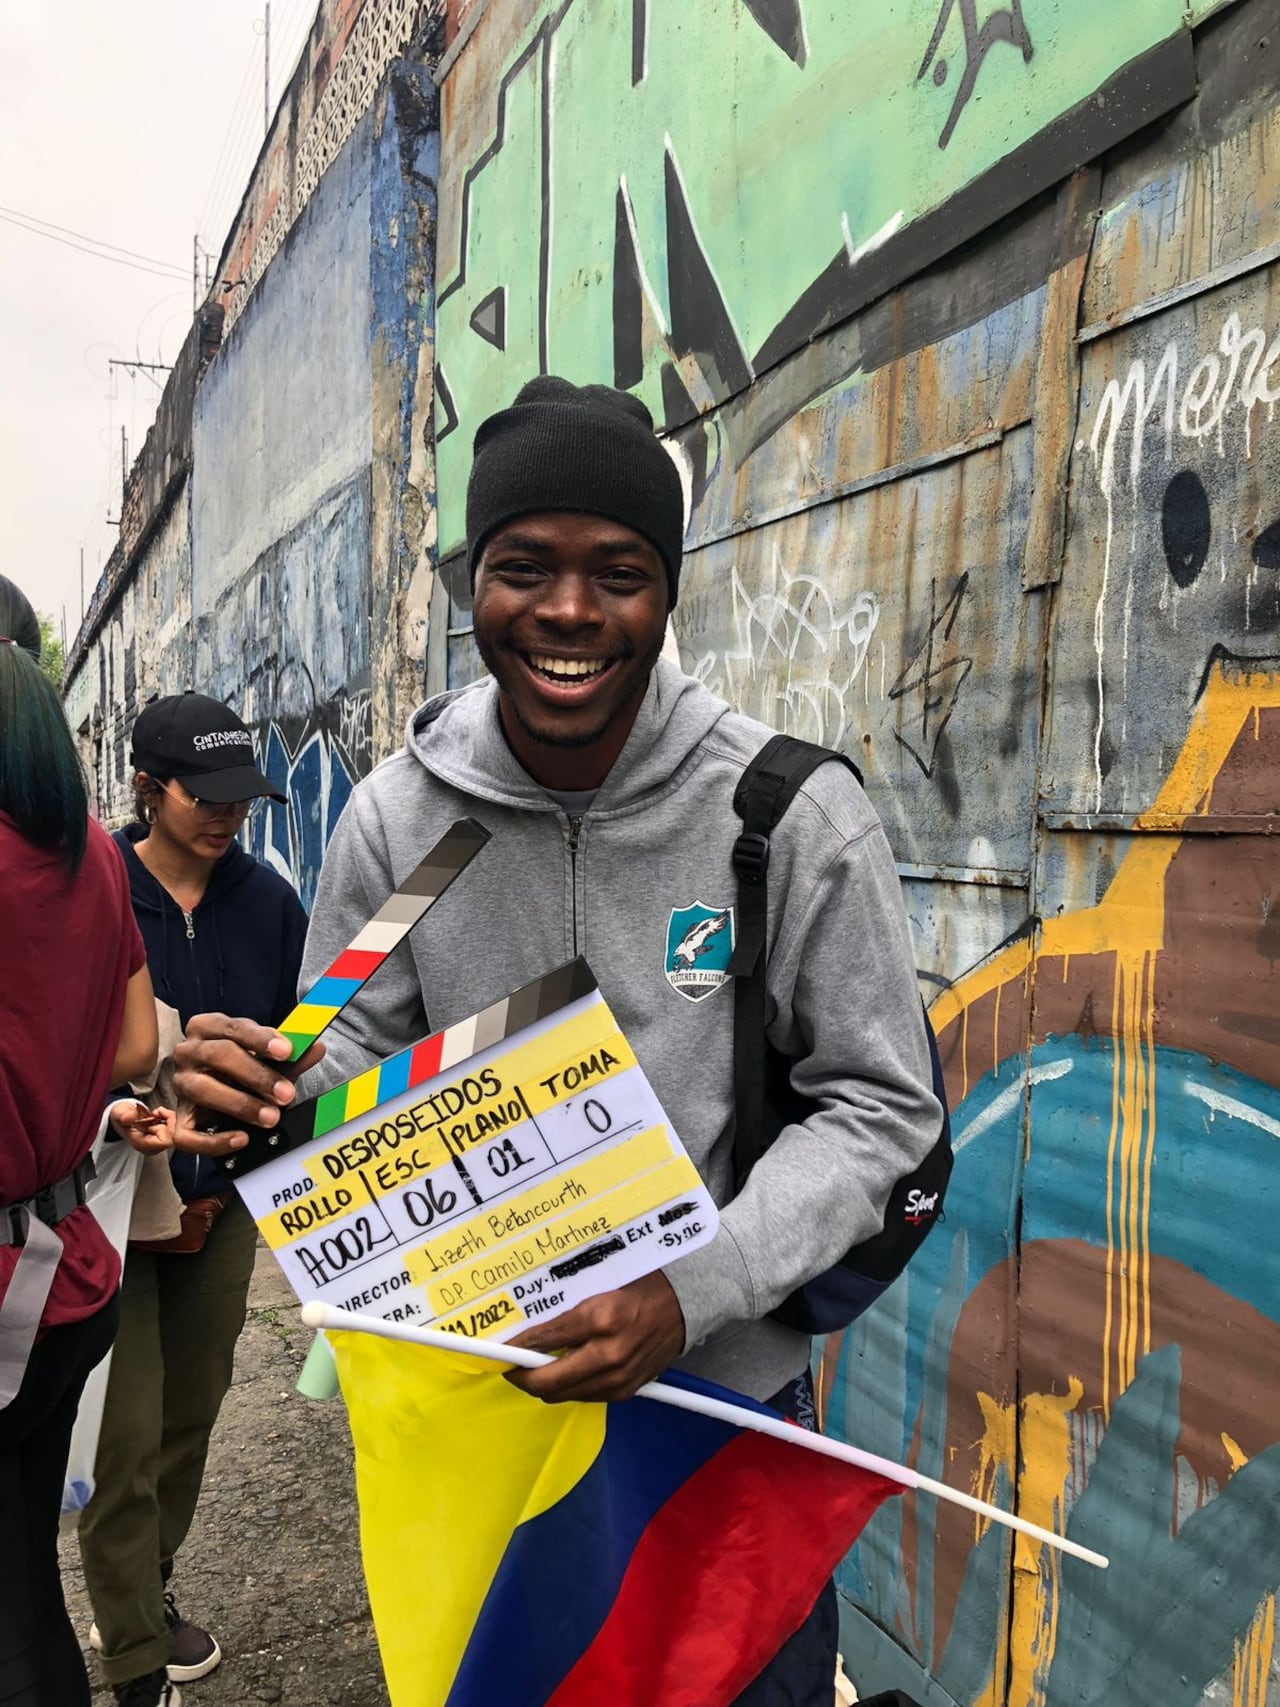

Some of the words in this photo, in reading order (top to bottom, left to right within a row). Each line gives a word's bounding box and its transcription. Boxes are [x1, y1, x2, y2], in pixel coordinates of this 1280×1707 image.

[670, 972, 697, 984] FLETCHER
[699, 972, 726, 984] FALCONS
[280, 1189, 352, 1236] ROLLO
[376, 1149, 431, 1190] ESC
[451, 1100, 522, 1152] PLANO
[540, 1049, 621, 1098] TOMA
[272, 1177, 317, 1207] PROD.
[295, 1217, 394, 1288] A002
[403, 1179, 457, 1227] 06
[487, 1138, 535, 1178] 01
[584, 1099, 612, 1133] 0
[488, 1179, 587, 1239] Betancourth
[626, 1220, 654, 1243] Ext
[471, 1249, 535, 1293] Camilo
[535, 1216, 613, 1256] Martinez
[523, 1290, 565, 1319] Filter
